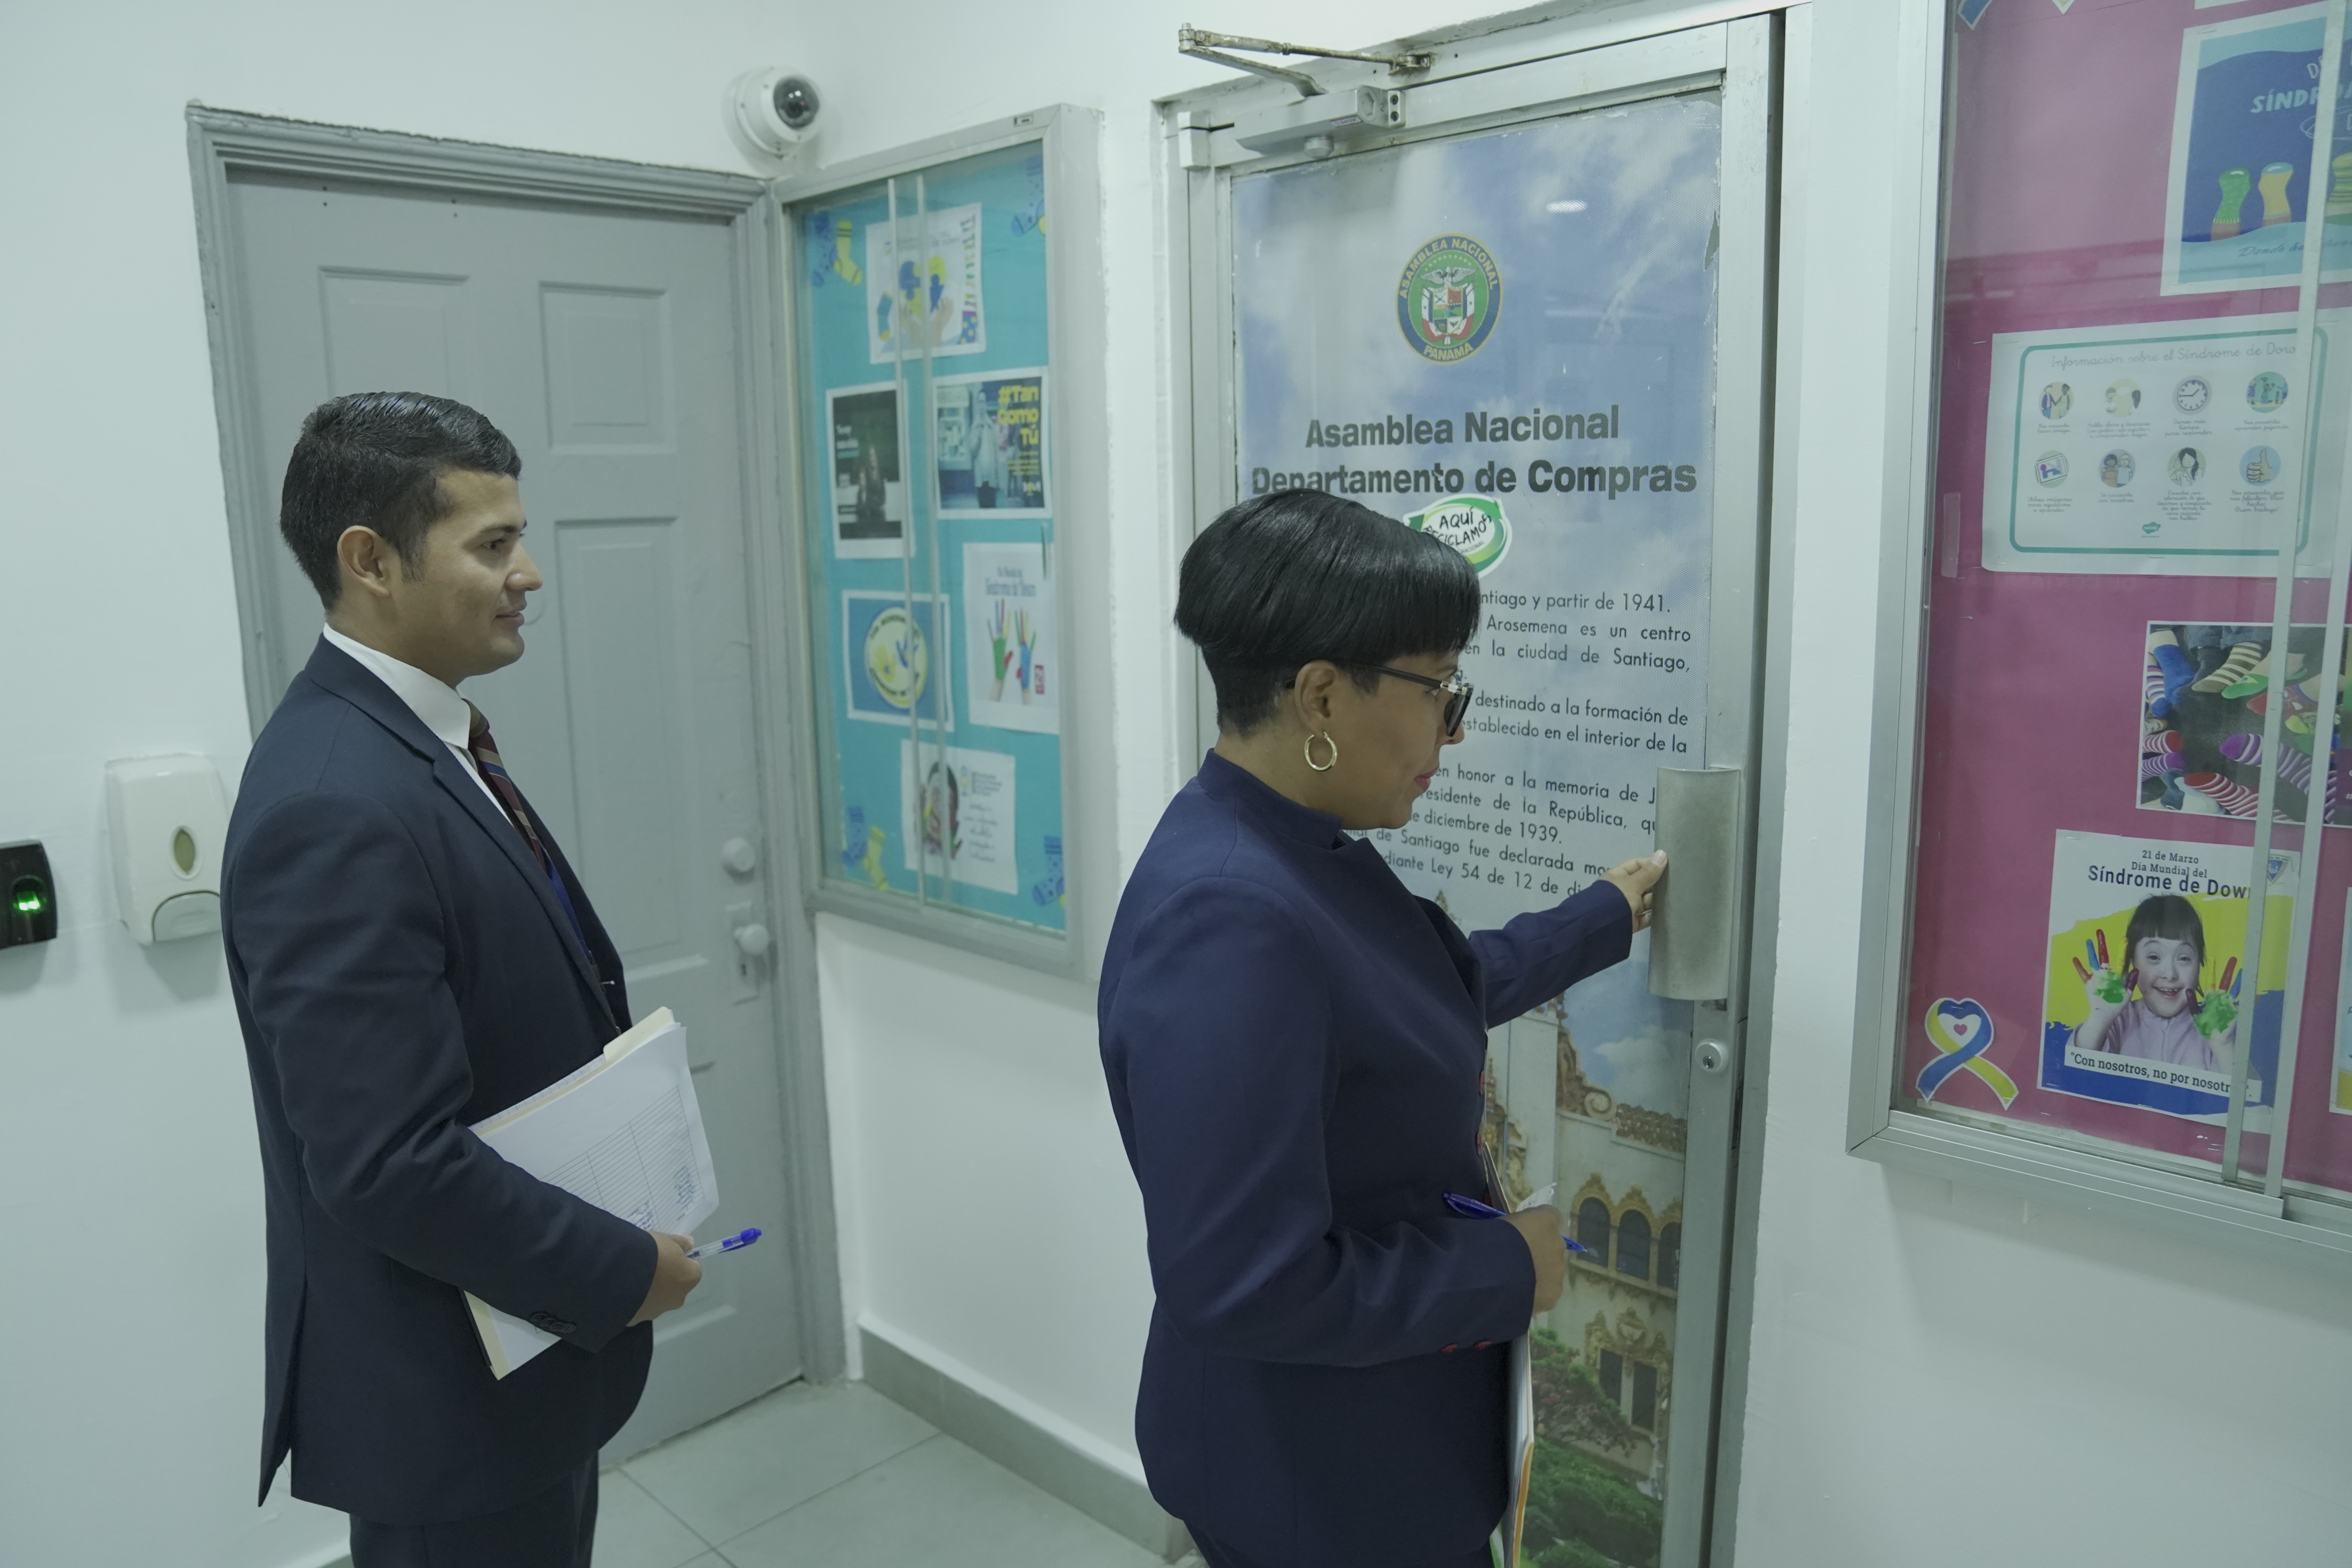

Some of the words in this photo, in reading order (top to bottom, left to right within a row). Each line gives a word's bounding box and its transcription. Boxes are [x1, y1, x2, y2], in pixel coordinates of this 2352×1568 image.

[2238, 243, 2286, 257] Donde
[1399, 239, 1448, 299] ASAMBLEA
[1451, 238, 1499, 290] NACIONAL
[2051, 354, 2123, 371] Información
[2128, 350, 2160, 363] sobre
[2163, 348, 2174, 361] el
[2177, 347, 2241, 360] Síndrome
[2246, 343, 2263, 356] de
[2266, 341, 2296, 355] Dow
[1306, 414, 1453, 448] Asamblea
[1465, 404, 1619, 444] Nacional
[1252, 463, 1465, 494] Departamento
[1476, 461, 1517, 493] de
[1528, 460, 1697, 500] Compras
[1439, 506, 1474, 530] AQUÍ
[1461, 541, 1485, 554] NACIONAL
[1481, 591, 1526, 610] ntiago
[1532, 595, 1541, 610] y
[1547, 593, 1589, 611] partir
[1595, 592, 1614, 610] de
[1623, 593, 1671, 613] 1941.
[1486, 614, 1567, 635] Arosemena
[1581, 625, 1596, 637] es
[1610, 626, 1627, 638] un
[1641, 627, 1691, 642] centro
[1465, 644, 1480, 655] en
[1492, 641, 1505, 657] la
[1517, 644, 1568, 661] ciudad
[1581, 645, 1599, 663] de
[1613, 648, 1690, 673] Santiago,
[1475, 691, 1545, 712] destinado
[1551, 702, 1560, 713] a
[1566, 698, 1579, 715] la
[1585, 699, 1662, 724] formación
[1668, 707, 1688, 726] de
[1545, 728, 1561, 740] en
[1567, 725, 1579, 742] el
[1585, 728, 1640, 748] interior
[1646, 733, 1666, 751] de
[1672, 734, 1687, 753] la
[1435, 767, 1449, 778] en
[1457, 763, 1495, 784] honor
[1504, 774, 1514, 786] a
[1523, 771, 1536, 790] la
[1545, 779, 1610, 799] memoria
[1619, 783, 1639, 803] de
[1421, 786, 1481, 807] esidente
[1493, 790, 1510, 811] de
[1523, 795, 1536, 815] la
[1549, 800, 1627, 830] República,
[1424, 808, 1489, 833] diciembre
[1494, 815, 1512, 836] de
[1519, 822, 1562, 845] 1939.
[1376, 828, 1392, 841] de
[1400, 829, 1459, 855] Santiago
[1469, 838, 1490, 858] fue
[1499, 844, 1573, 872] declarada
[2142, 850, 2152, 859] 21
[2155, 851, 2166, 860] de
[2169, 852, 2199, 864] Marzo
[1384, 850, 1423, 871] diante
[1431, 857, 1452, 879] Ley
[1461, 862, 1479, 880] 54
[1488, 866, 1505, 885] de
[1514, 872, 1532, 889] 12
[1541, 875, 1558, 895] de
[2088, 865, 2172, 890] Síndrome
[2179, 875, 2200, 893] de
[2207, 879, 2250, 900] Dow
[2131, 861, 2147, 871] Día
[2150, 863, 2190, 877] Mundial
[2192, 868, 2208, 878] del
[2070, 1051, 2095, 1067] "Con
[2098, 1057, 2150, 1079] nosotros,
[2152, 1067, 2167, 1080] no
[2171, 1071, 2190, 1086] por
